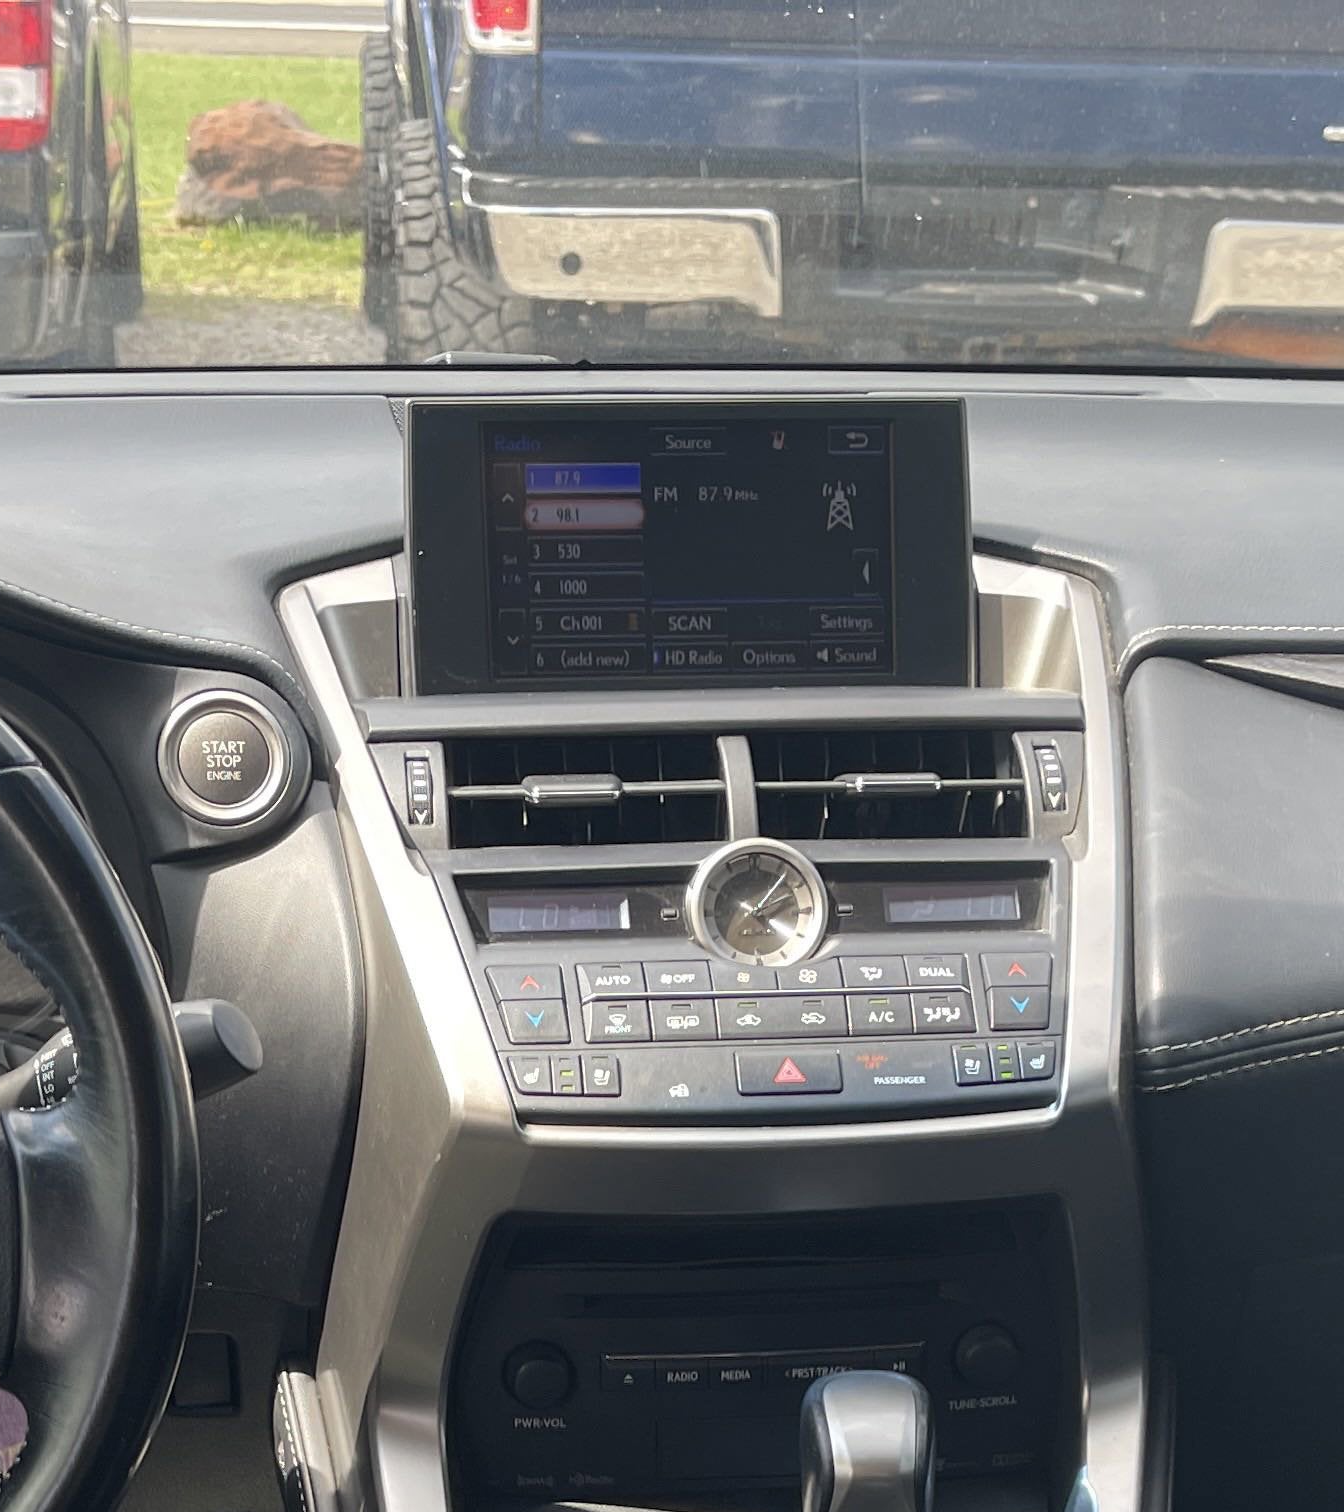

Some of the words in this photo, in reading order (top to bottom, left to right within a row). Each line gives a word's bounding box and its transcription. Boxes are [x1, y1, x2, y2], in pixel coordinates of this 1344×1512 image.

[494, 435, 542, 451] Radio
[665, 434, 712, 450] Source
[654, 486, 678, 501] FM
[532, 507, 539, 523] 2
[556, 507, 581, 523] 98.1
[533, 543, 541, 560] 3
[557, 543, 581, 559] 530
[534, 579, 541, 595] 4
[559, 579, 588, 595] 1000
[535, 615, 544, 632] 5
[668, 615, 712, 631] SCAN
[820, 613, 873, 632] Settings
[536, 652, 544, 667] 6
[560, 649, 593, 668] (add
[596, 649, 631, 667] new)
[665, 650, 685, 665] HD
[689, 649, 723, 665] Radio
[743, 649, 796, 667] Options
[835, 647, 877, 664] Sound
[201, 740, 246, 754] START
[206, 755, 242, 768] STOP
[206, 770, 242, 781] ENGINE
[672, 973, 696, 984] OFF
[919, 966, 955, 978] DUAL
[594, 975, 631, 986] AUTO
[868, 1010, 895, 1024] A/C
[605, 1024, 633, 1035] FRONT
[873, 1075, 927, 1085] PASSENGER
[667, 1370, 699, 1383] RADIO
[720, 1370, 751, 1382] MEDIA
